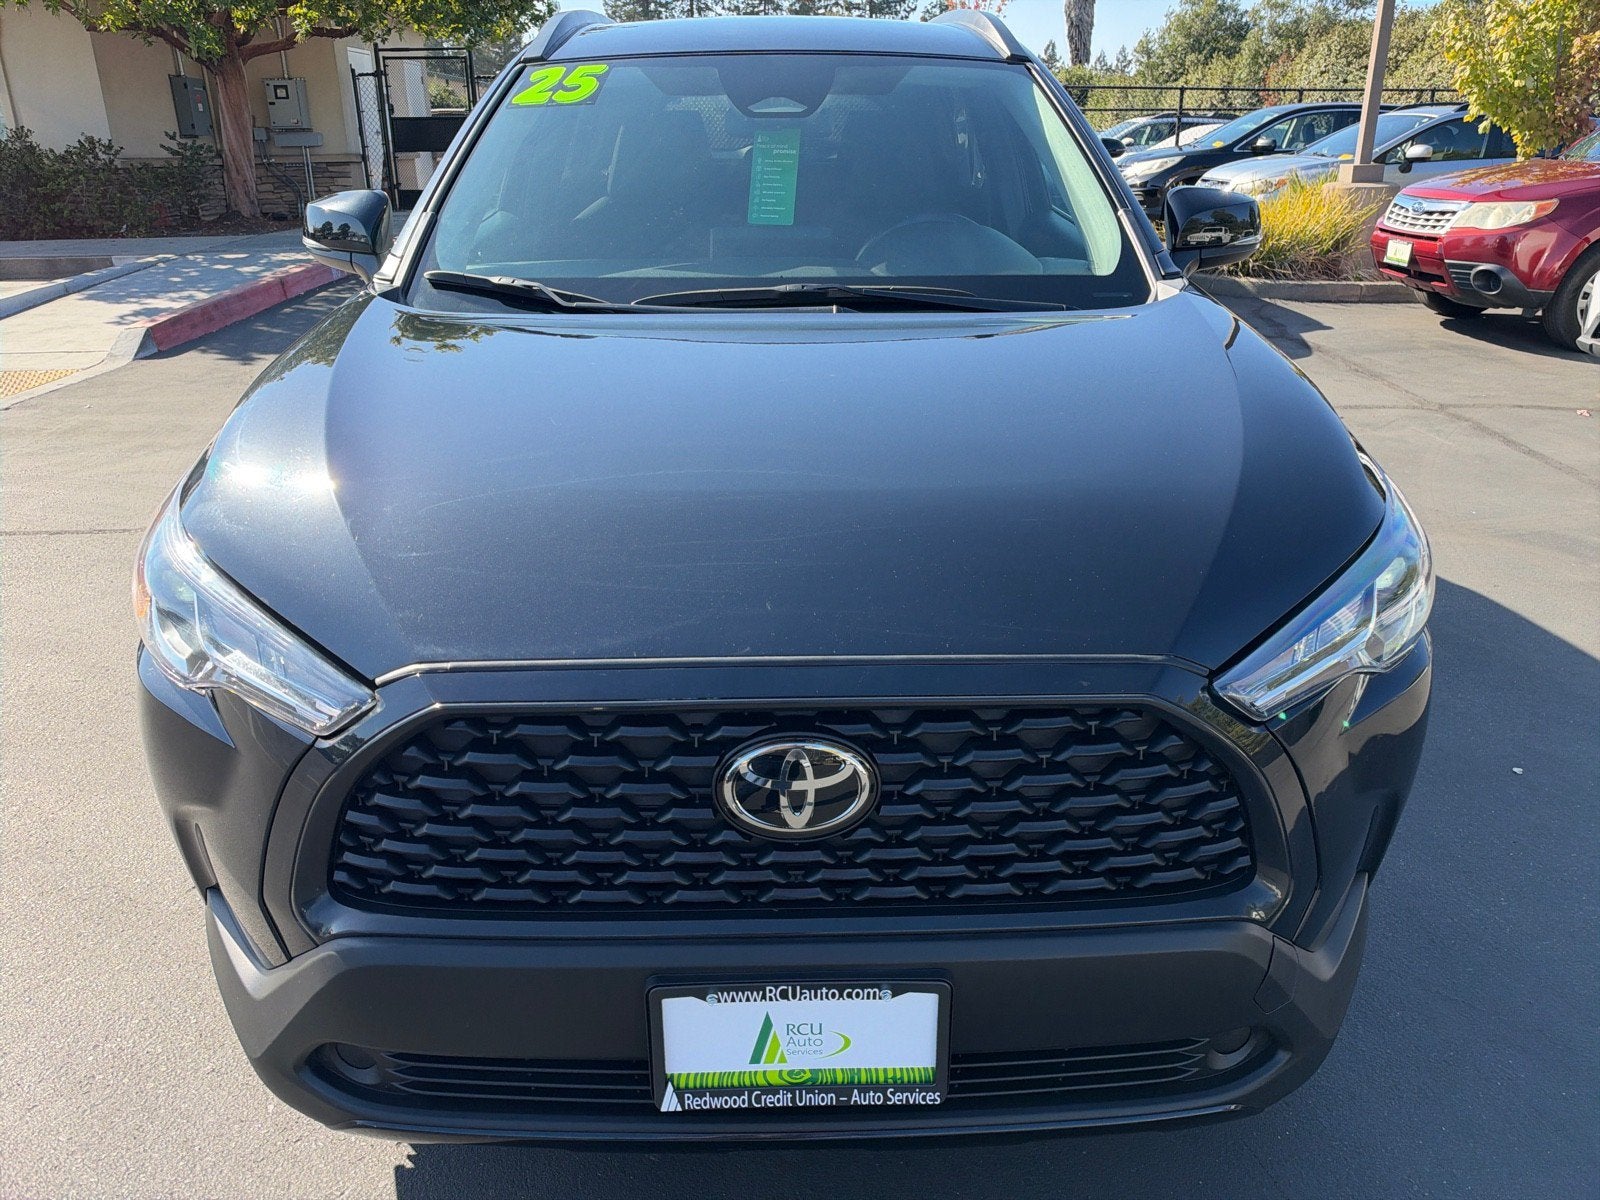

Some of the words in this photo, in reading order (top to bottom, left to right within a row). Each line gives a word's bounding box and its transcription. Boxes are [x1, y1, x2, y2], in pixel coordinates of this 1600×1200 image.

[512, 64, 609, 106] 25
[717, 985, 880, 1003] www.RCUauto.com
[785, 1022, 823, 1036] RCU
[785, 1036, 824, 1047] Auto
[786, 1048, 823, 1056] Services
[684, 1091, 749, 1110] Redwood
[751, 1089, 793, 1108] Credit
[795, 1089, 836, 1106] Union
[850, 1088, 884, 1106] Auto
[886, 1088, 941, 1105] Services
